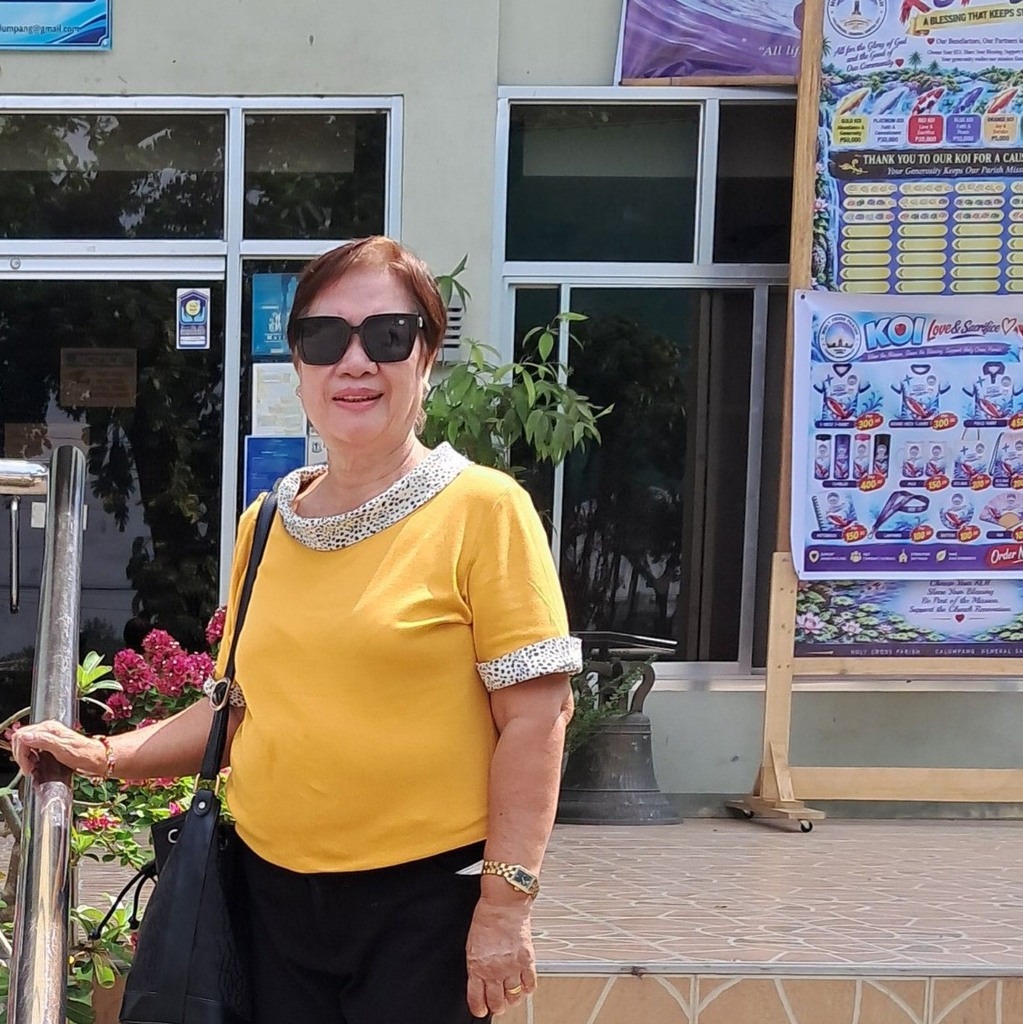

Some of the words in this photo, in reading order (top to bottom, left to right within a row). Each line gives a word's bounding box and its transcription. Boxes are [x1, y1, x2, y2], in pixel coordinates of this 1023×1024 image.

[923, 17, 929, 26] A
[930, 13, 967, 26] BLESSING
[968, 11, 988, 21] THAT
[989, 8, 1014, 19] KEEPS
[786, 45, 801, 58] lif
[863, 154, 896, 165] THANK
[897, 153, 916, 164] YOU
[917, 153, 931, 164] TO
[932, 153, 953, 164] OUR
[955, 153, 971, 164] KOI
[973, 153, 992, 163] FOR
[994, 153, 1001, 163] A
[887, 167, 904, 175] Your
[904, 166, 942, 176] Generosity
[943, 166, 964, 176] Keeps
[965, 166, 981, 174] Our
[980, 165, 1004, 175] Parish
[864, 315, 925, 350] KOI
[859, 419, 874, 429] 300
[933, 419, 949, 428] 300
[928, 481, 941, 490] 150
[846, 531, 860, 541] 150
[991, 548, 1017, 564] Order
